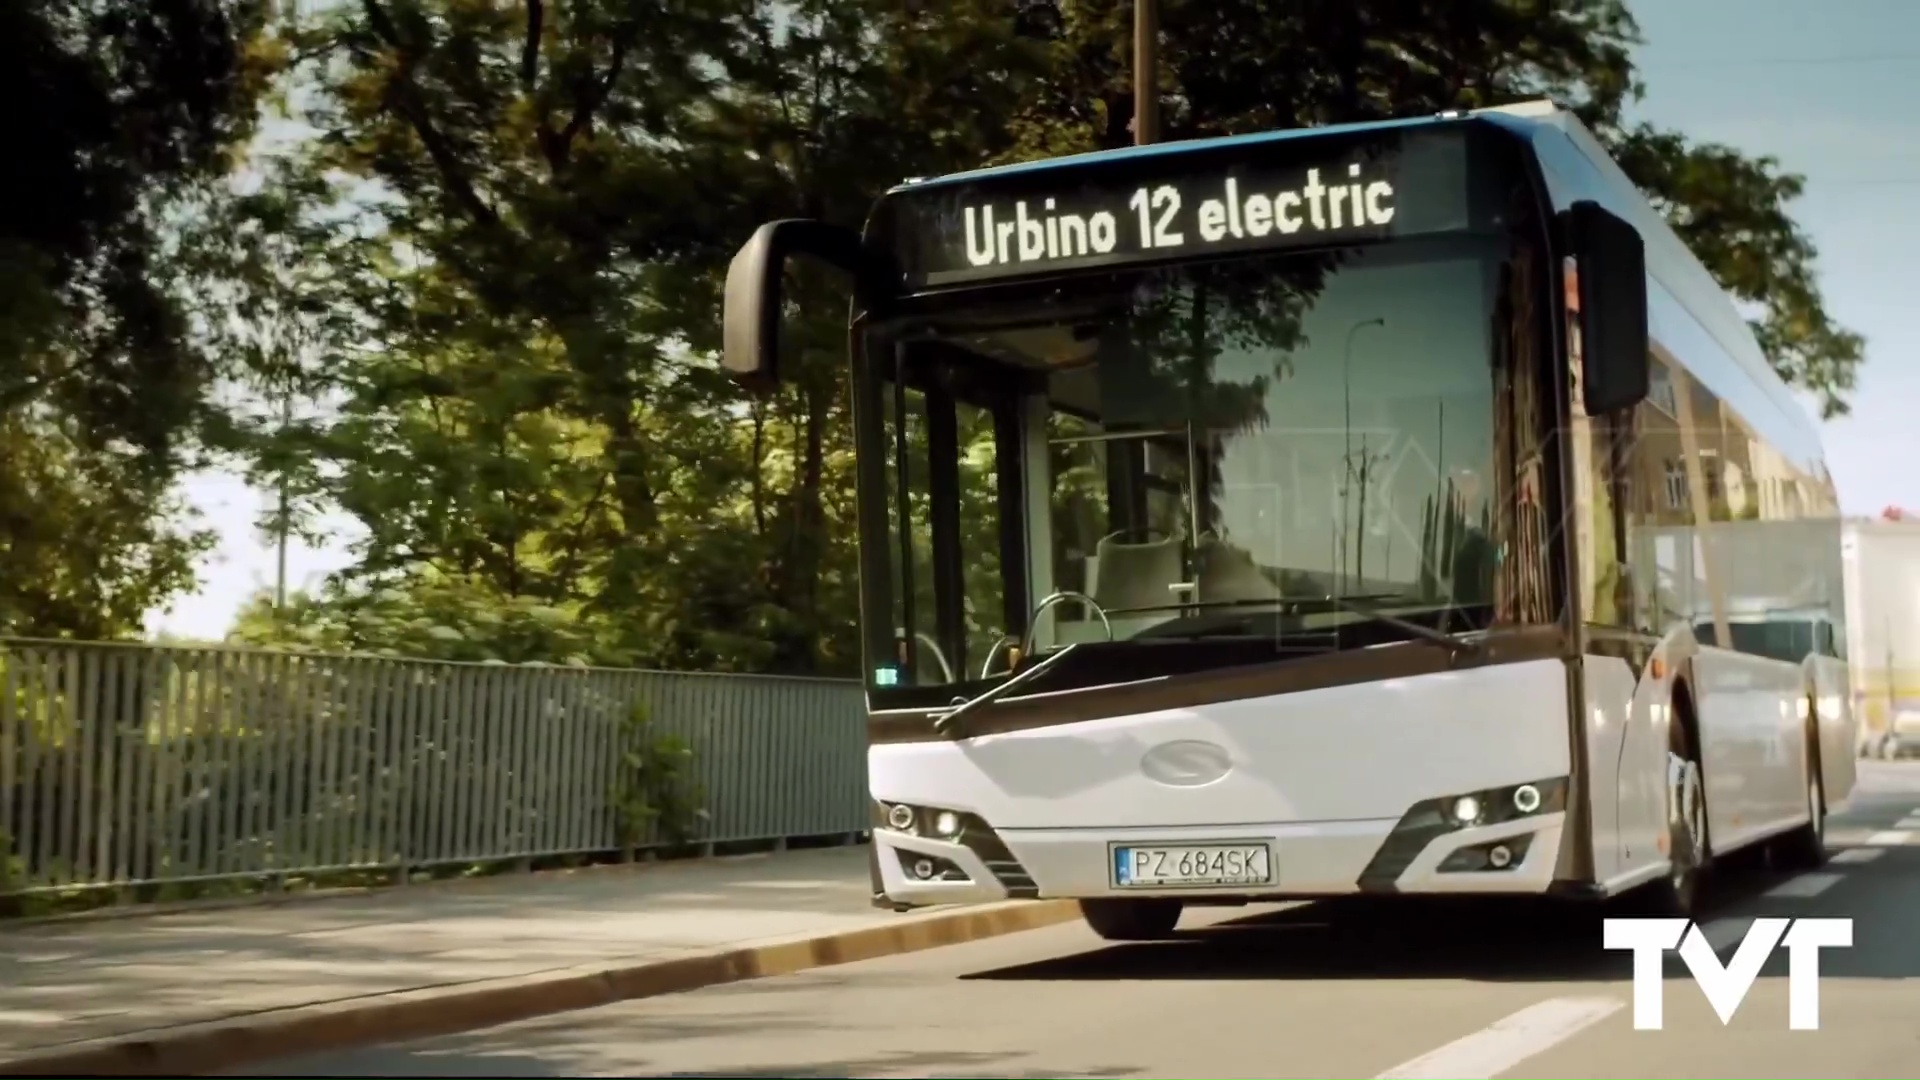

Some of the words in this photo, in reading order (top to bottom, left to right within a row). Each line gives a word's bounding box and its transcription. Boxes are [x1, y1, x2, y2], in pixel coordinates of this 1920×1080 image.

[964, 198, 1116, 266] Urbino
[1129, 185, 1184, 249] 12
[1198, 163, 1395, 242] electric
[1136, 851, 1169, 877] PZ
[1179, 849, 1259, 877] 684SK
